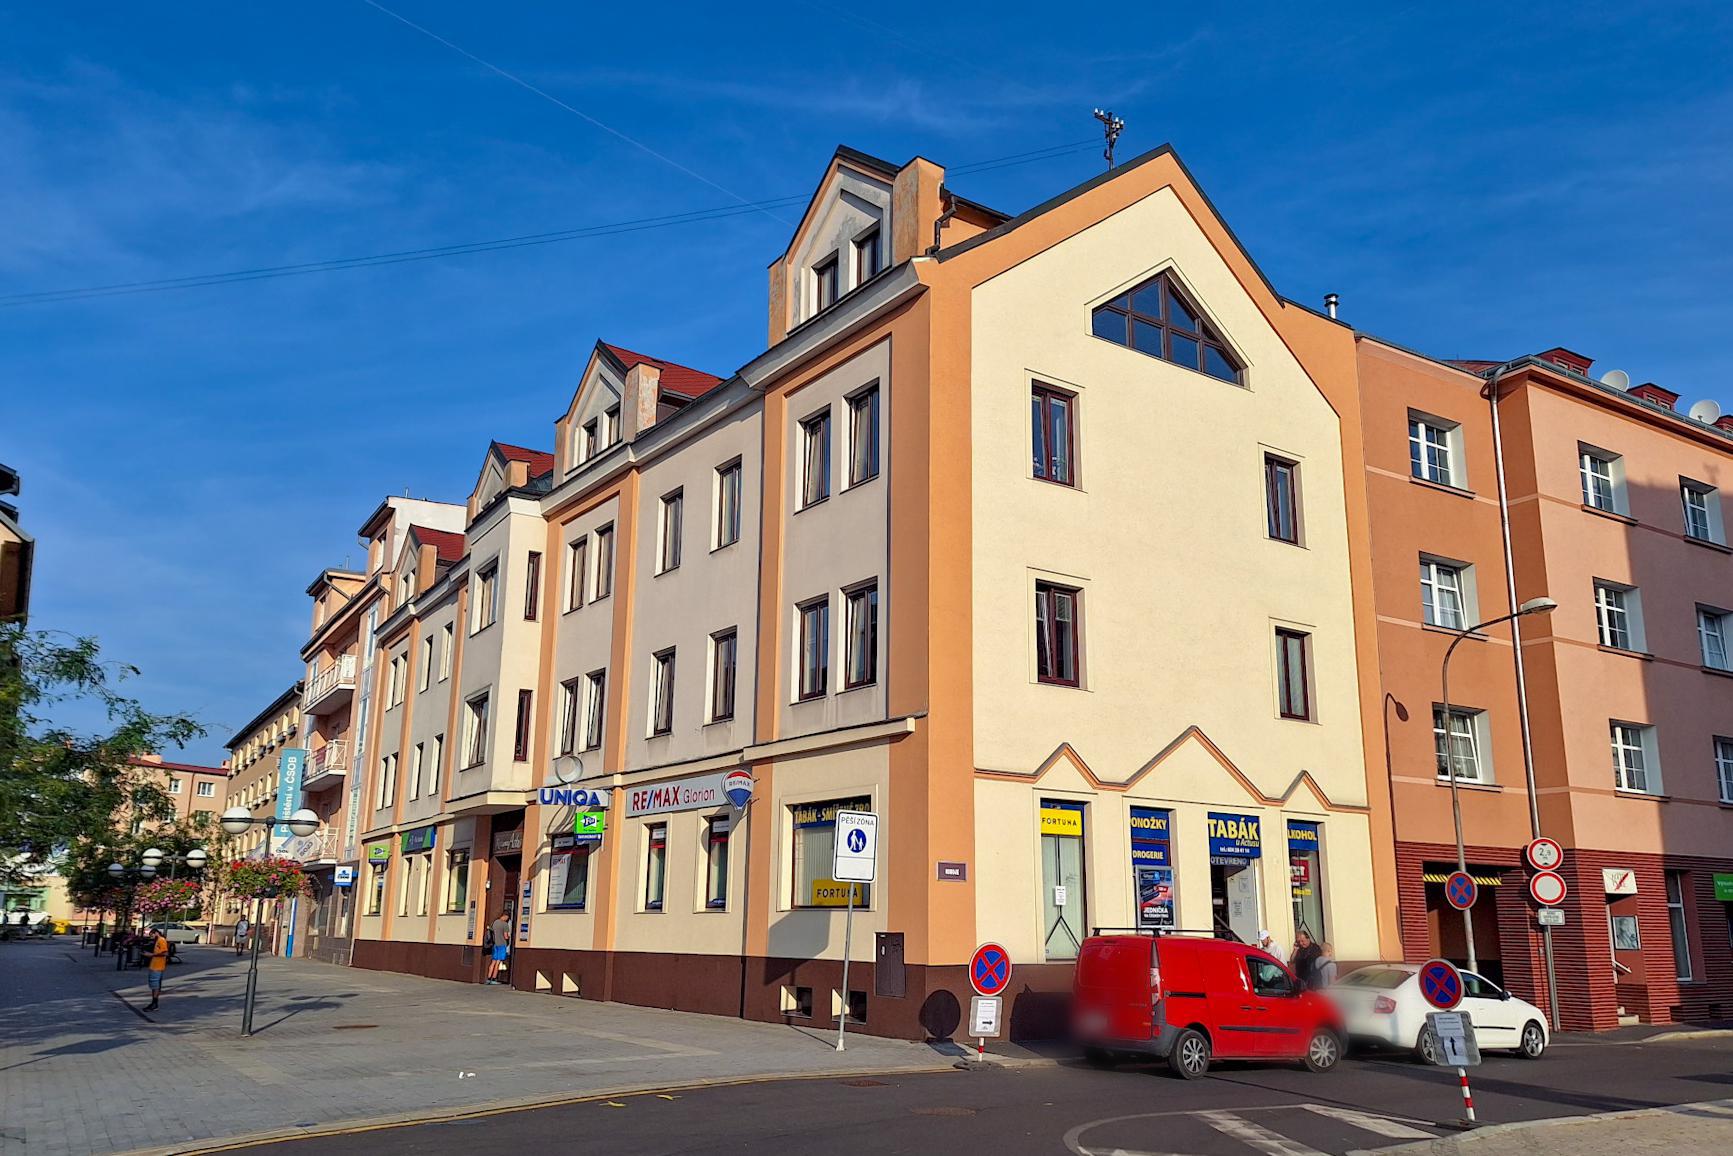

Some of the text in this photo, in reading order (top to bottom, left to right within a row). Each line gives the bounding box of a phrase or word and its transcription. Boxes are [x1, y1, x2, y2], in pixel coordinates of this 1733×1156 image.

[284, 756, 297, 784] ČSOB
[540, 788, 601, 806] UNIQA
[632, 785, 715, 811] RE/MAX Glorion
[280, 792, 294, 833] Pištění
[794, 806, 818, 824] TABÁK
[841, 816, 875, 826] PĚŠÍ ZÓNA
[1131, 816, 1167, 830] ONOŽKY
[1208, 817, 1260, 840] TABÁK
[1132, 849, 1164, 860] DROGERIE
